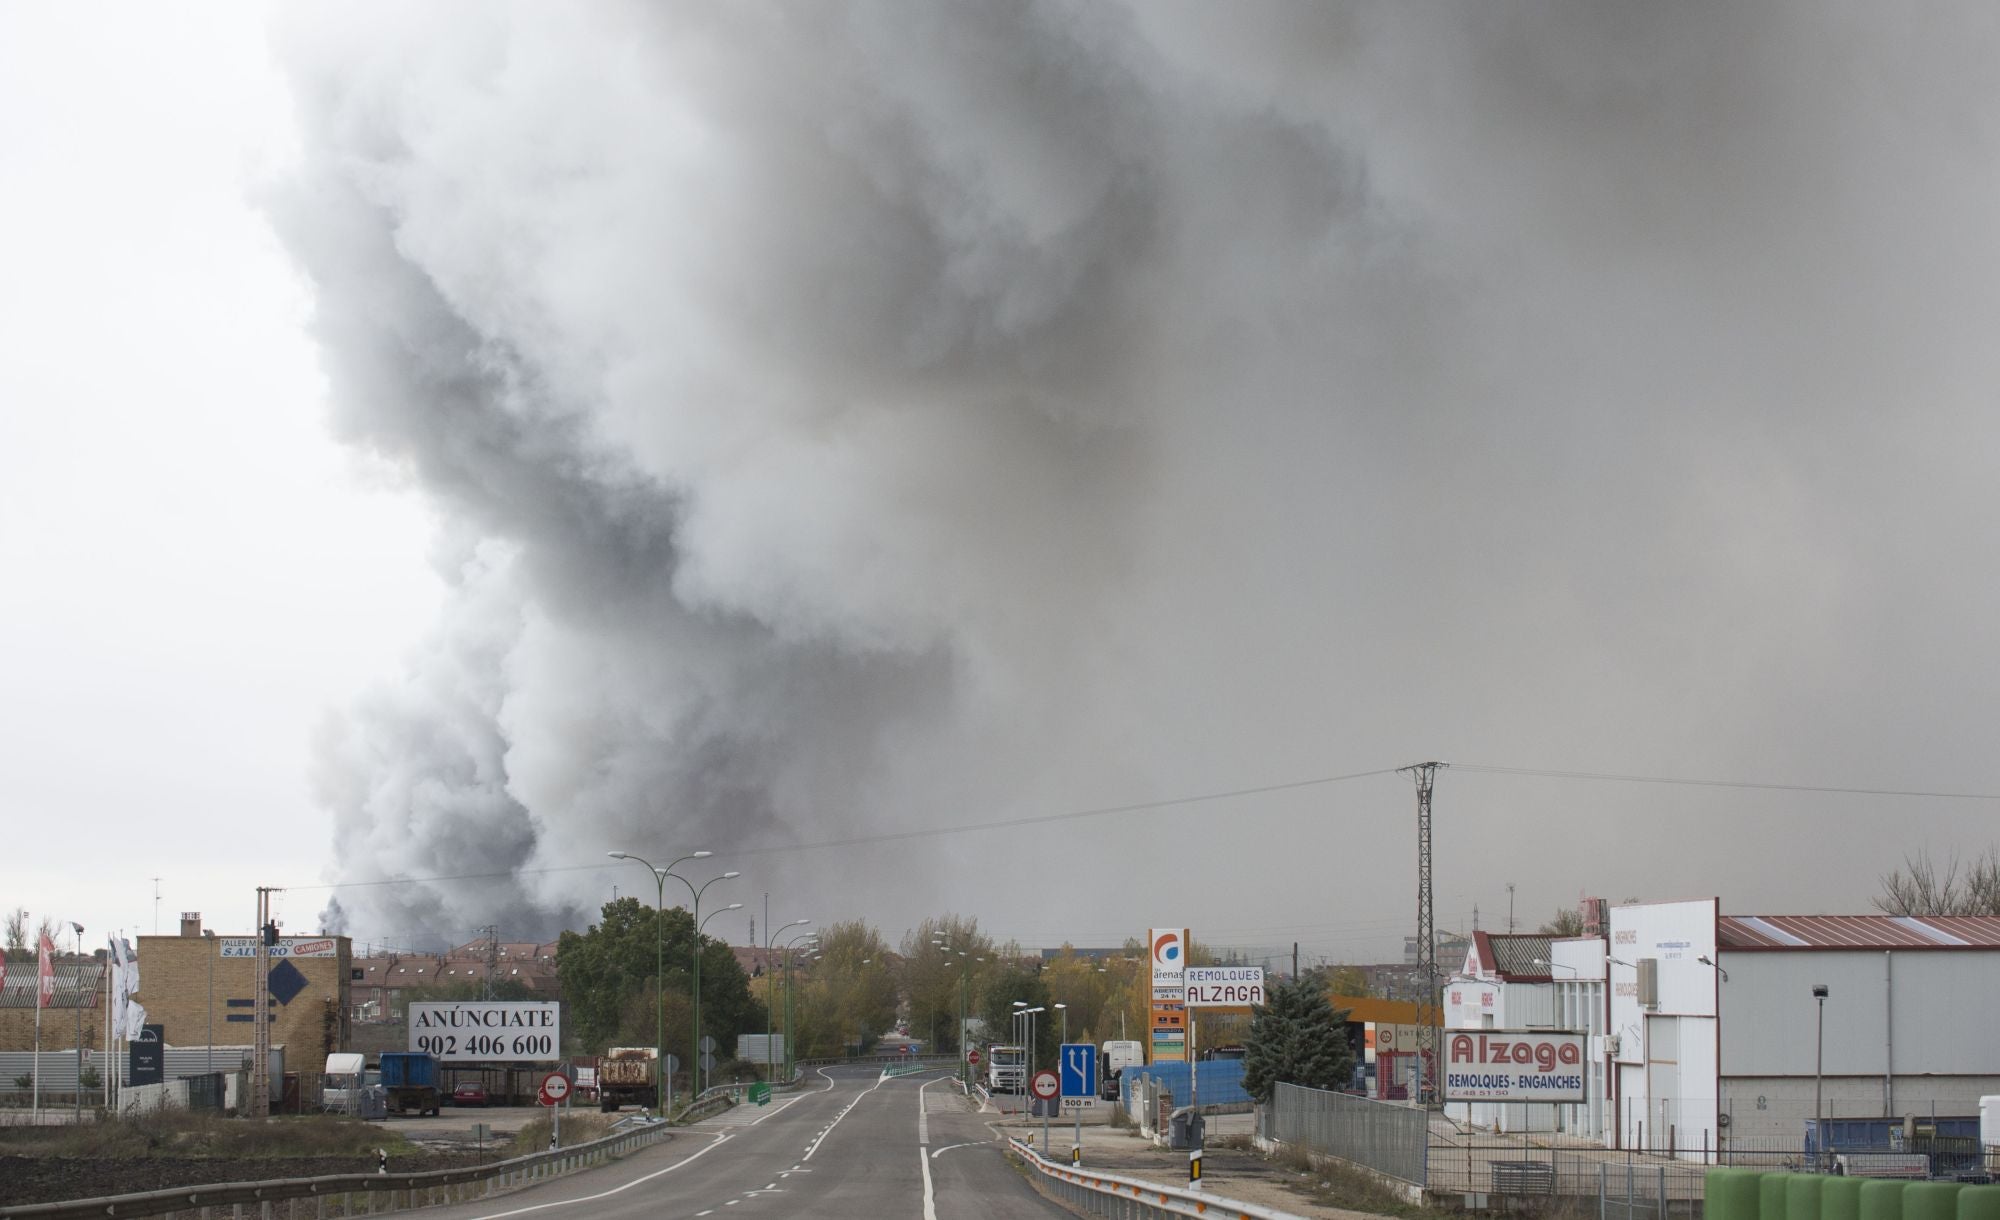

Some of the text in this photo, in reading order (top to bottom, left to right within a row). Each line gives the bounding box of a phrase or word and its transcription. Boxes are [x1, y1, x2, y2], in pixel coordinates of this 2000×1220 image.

[223, 948, 288, 956] S.ALVRO
[295, 941, 334, 955] CAMIONES
[1153, 971, 1183, 979] arenas
[1190, 970, 1259, 980] REMOLQUES
[1188, 985, 1260, 1002] ALZAGA
[416, 1005, 554, 1028] ANÚNCIATE
[418, 1035, 552, 1055] 902 406 600
[1451, 1034, 1580, 1073] Alzaga
[1449, 1074, 1510, 1089] REMOLQUES
[1518, 1075, 1581, 1089] ENGANCHES
